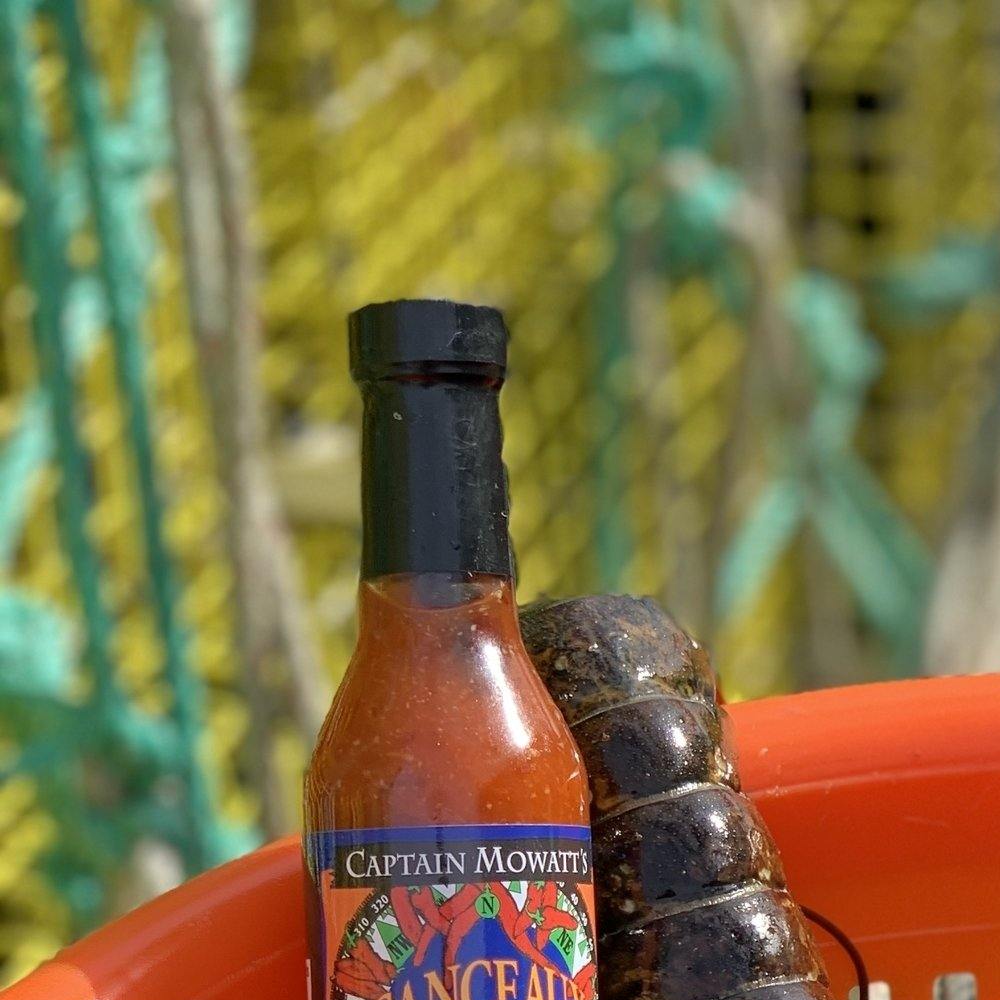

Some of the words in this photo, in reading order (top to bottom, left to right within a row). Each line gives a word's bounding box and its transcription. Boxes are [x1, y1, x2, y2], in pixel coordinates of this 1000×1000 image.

[345, 849, 466, 879] CAPTAIN
[474, 846, 588, 876] MOWATT'S
[371, 894, 389, 914] 320
[482, 896, 494, 915] N
[353, 917, 370, 937] 310
[556, 929, 574, 956] NE
